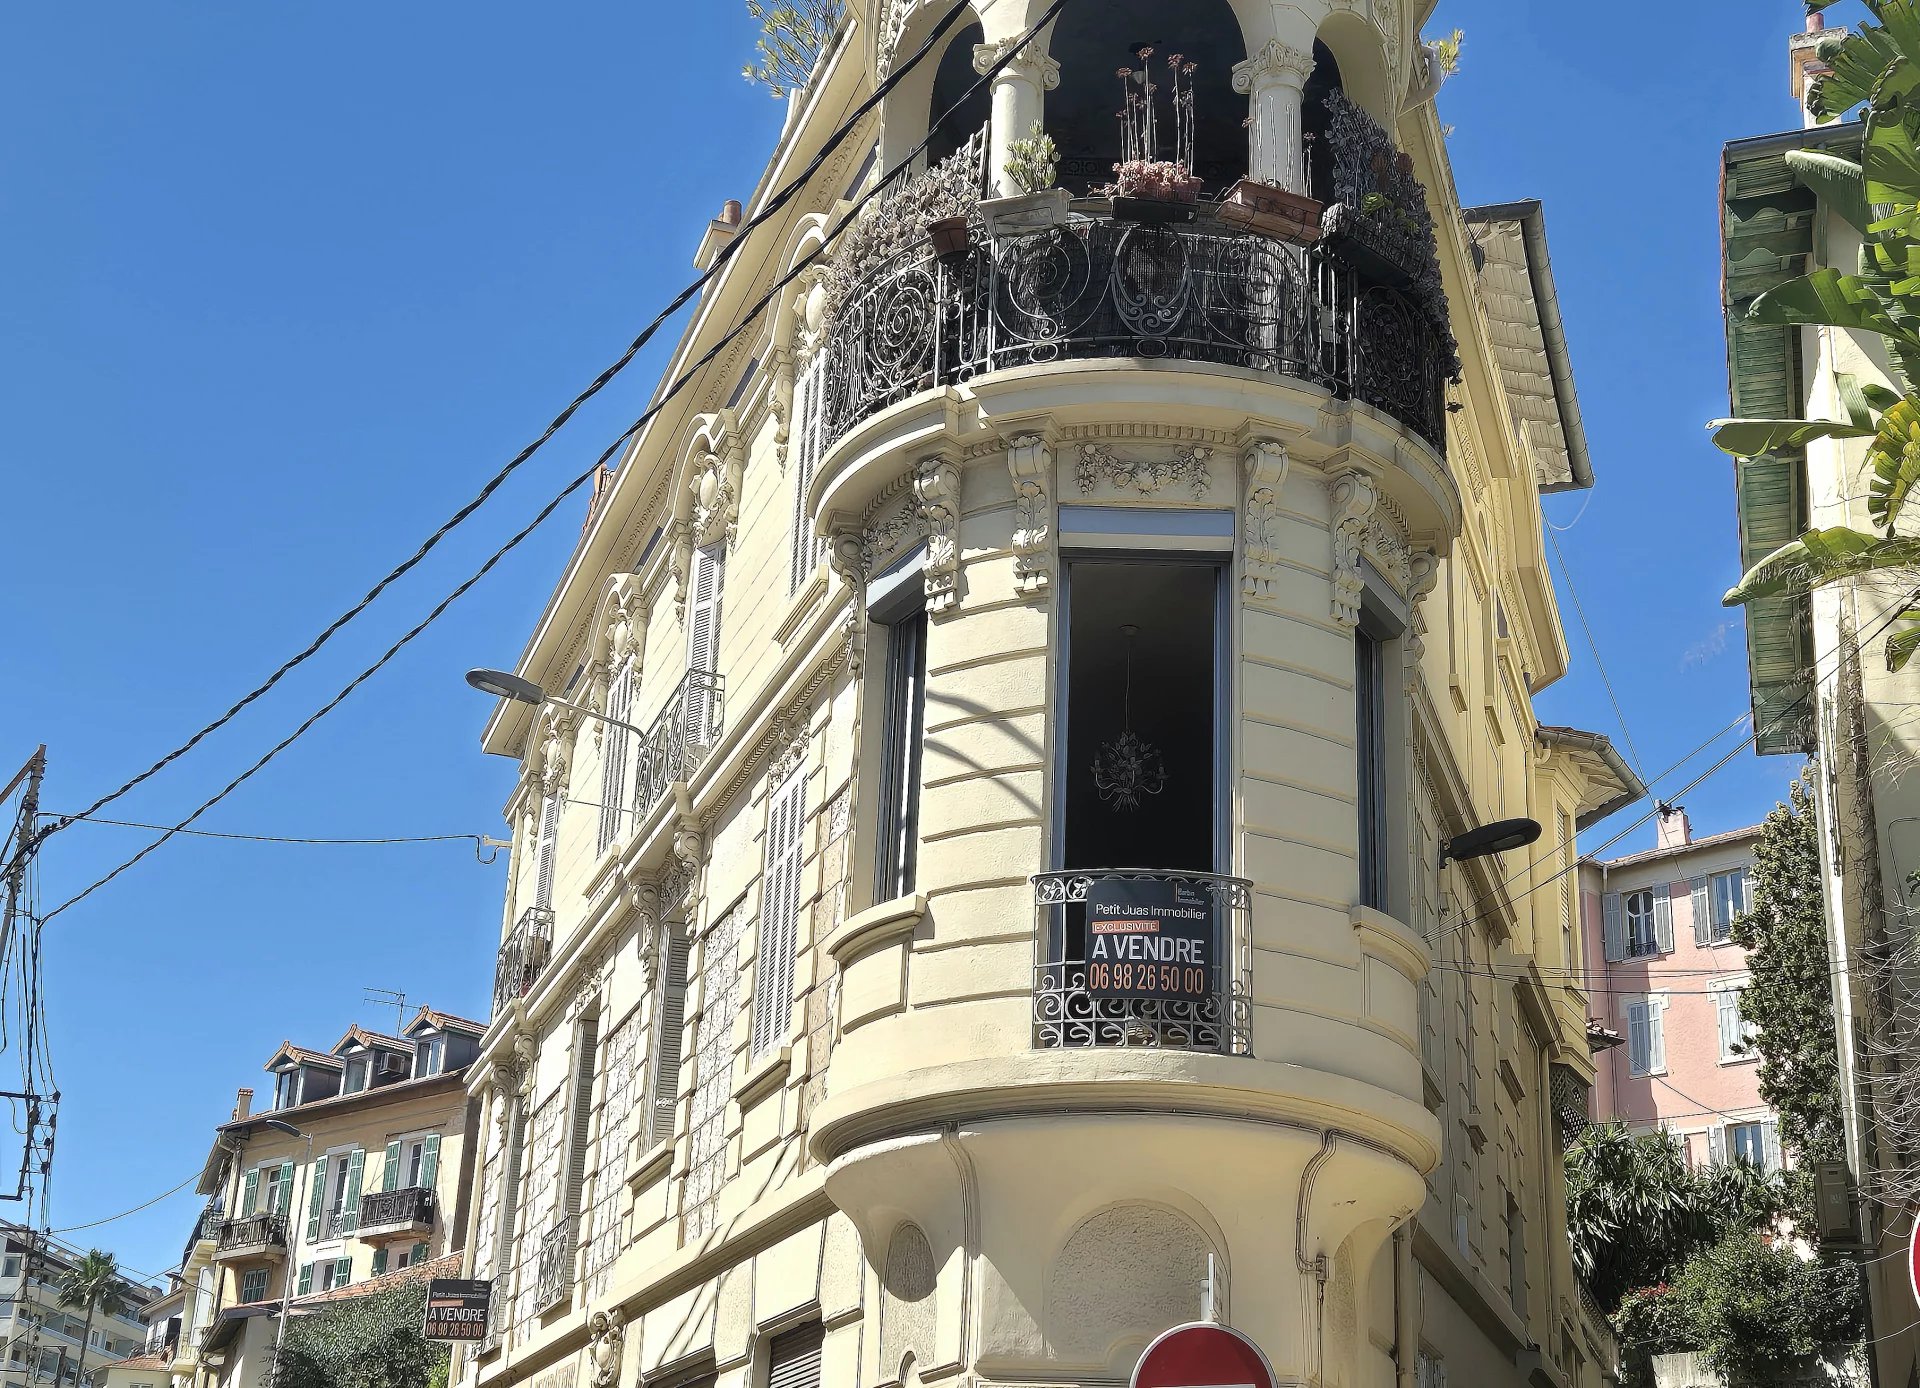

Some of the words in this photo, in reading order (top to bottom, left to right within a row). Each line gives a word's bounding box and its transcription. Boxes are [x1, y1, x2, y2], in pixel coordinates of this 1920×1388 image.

[1096, 903, 1121, 915] Petit
[1122, 904, 1149, 916] Juas
[1151, 905, 1207, 920] Immobilier
[1091, 934, 1108, 959] A
[1113, 934, 1205, 965] VENDRE
[1089, 963, 1109, 990] 06
[1113, 963, 1133, 990] 98
[1136, 964, 1156, 991] 26
[1160, 965, 1180, 992] 50
[1184, 967, 1204, 994] 00
[428, 1307, 437, 1321] A
[440, 1307, 486, 1322] VENDRE
[449, 1322, 460, 1337] 26
[461, 1323, 471, 1337] 50
[472, 1323, 484, 1337] 00
